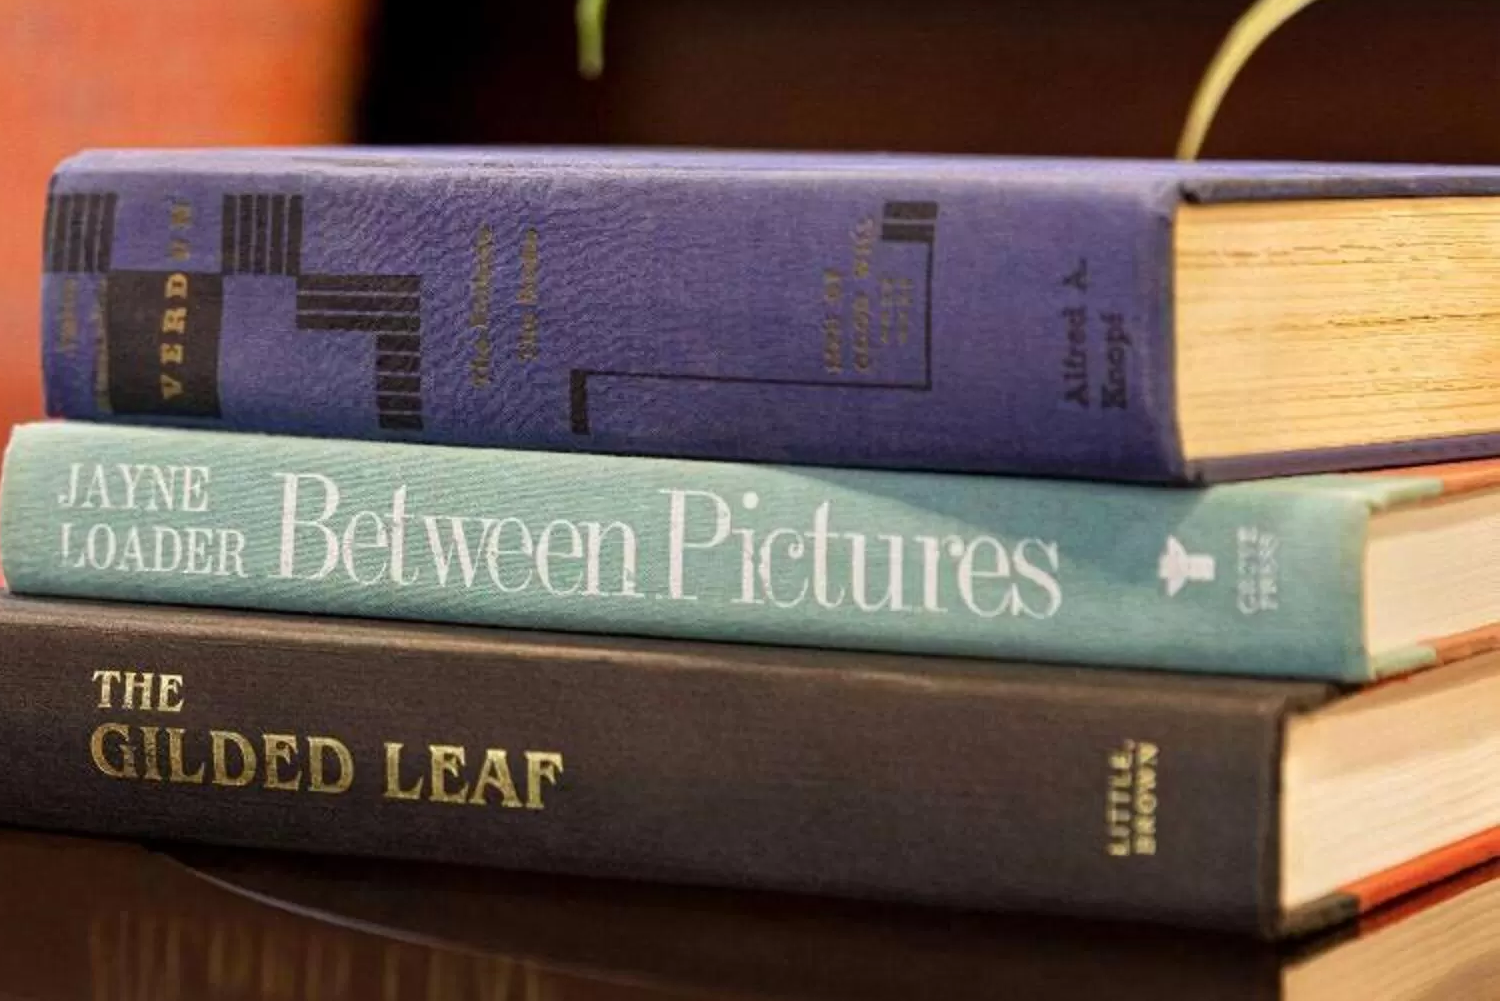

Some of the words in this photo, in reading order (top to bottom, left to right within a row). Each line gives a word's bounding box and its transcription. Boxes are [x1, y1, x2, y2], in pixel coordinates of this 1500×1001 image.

[159, 199, 193, 401] VERDUN
[1060, 305, 1089, 410] Alfred
[1099, 312, 1133, 411] Knopf
[57, 462, 210, 513] JAYNE
[59, 522, 250, 579] LOADER
[266, 472, 646, 600] Between
[657, 488, 1063, 620] Pictures
[91, 669, 185, 712] THE
[89, 721, 354, 795] GILDED
[383, 741, 566, 810] LEAF
[1133, 741, 1160, 856] BROWN
